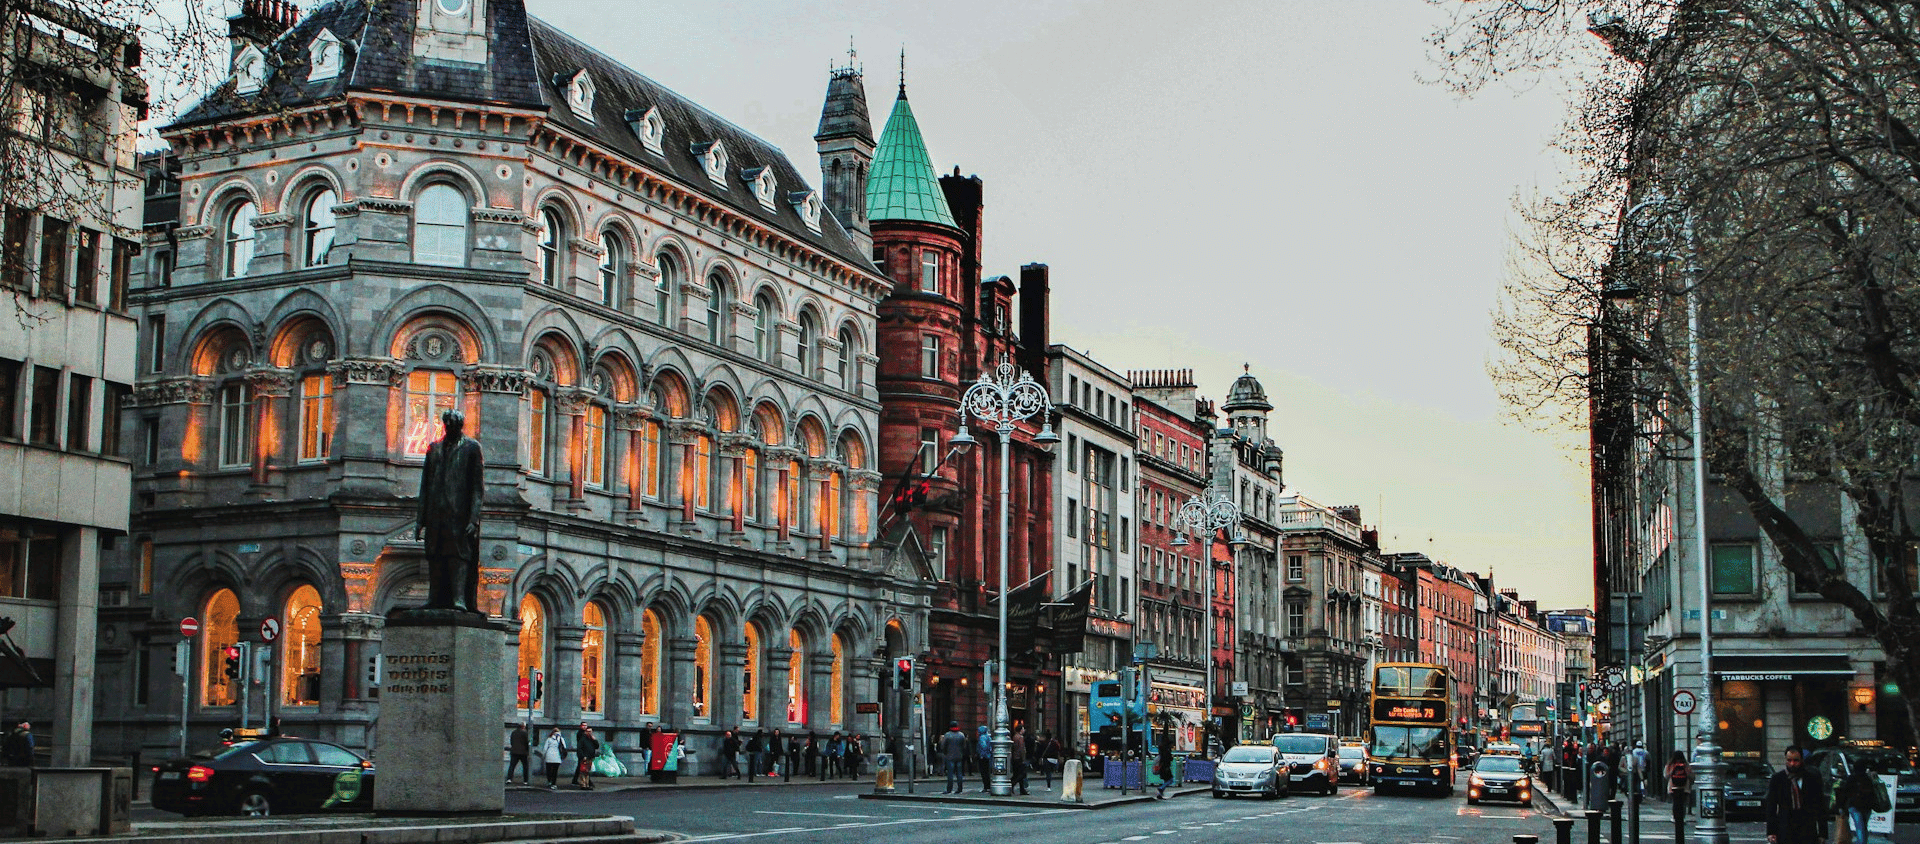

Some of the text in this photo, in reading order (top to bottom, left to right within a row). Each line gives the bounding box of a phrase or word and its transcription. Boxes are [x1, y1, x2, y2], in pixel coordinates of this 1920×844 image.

[1606, 667, 1624, 676] COSTA
[1605, 682, 1626, 691] COFFEE
[1424, 708, 1434, 718] 79
